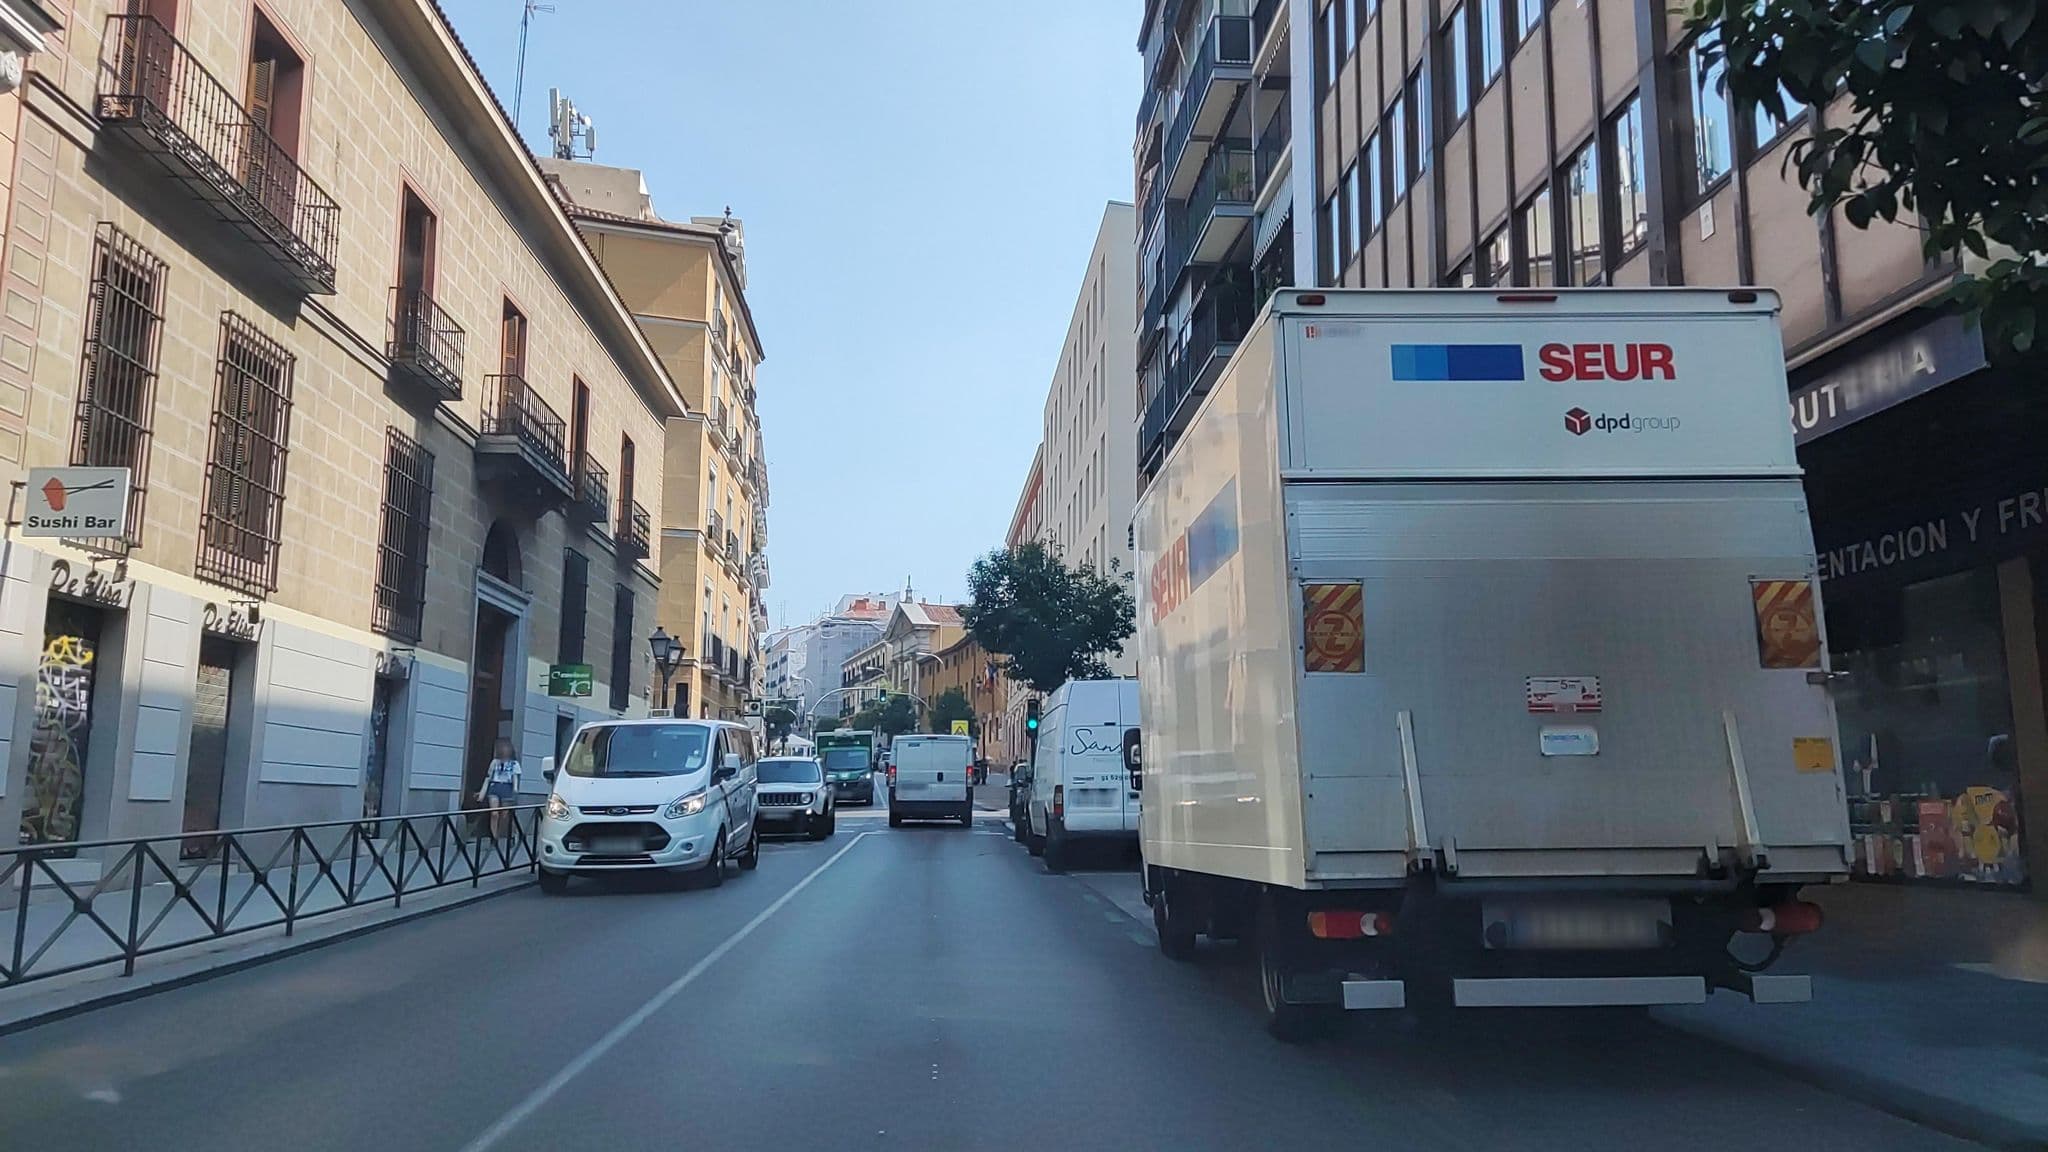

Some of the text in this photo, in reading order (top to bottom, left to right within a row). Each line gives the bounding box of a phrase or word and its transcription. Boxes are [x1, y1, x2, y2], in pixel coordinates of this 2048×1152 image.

[1538, 343, 1676, 382] SEUR
[1594, 413, 1681, 433] dpdgroup
[28, 516, 116, 529] Sushi Bar
[1961, 507, 1982, 542] Y
[1998, 487, 2048, 533] FR
[50, 558, 79, 595] De
[1151, 533, 1189, 627] SEUR
